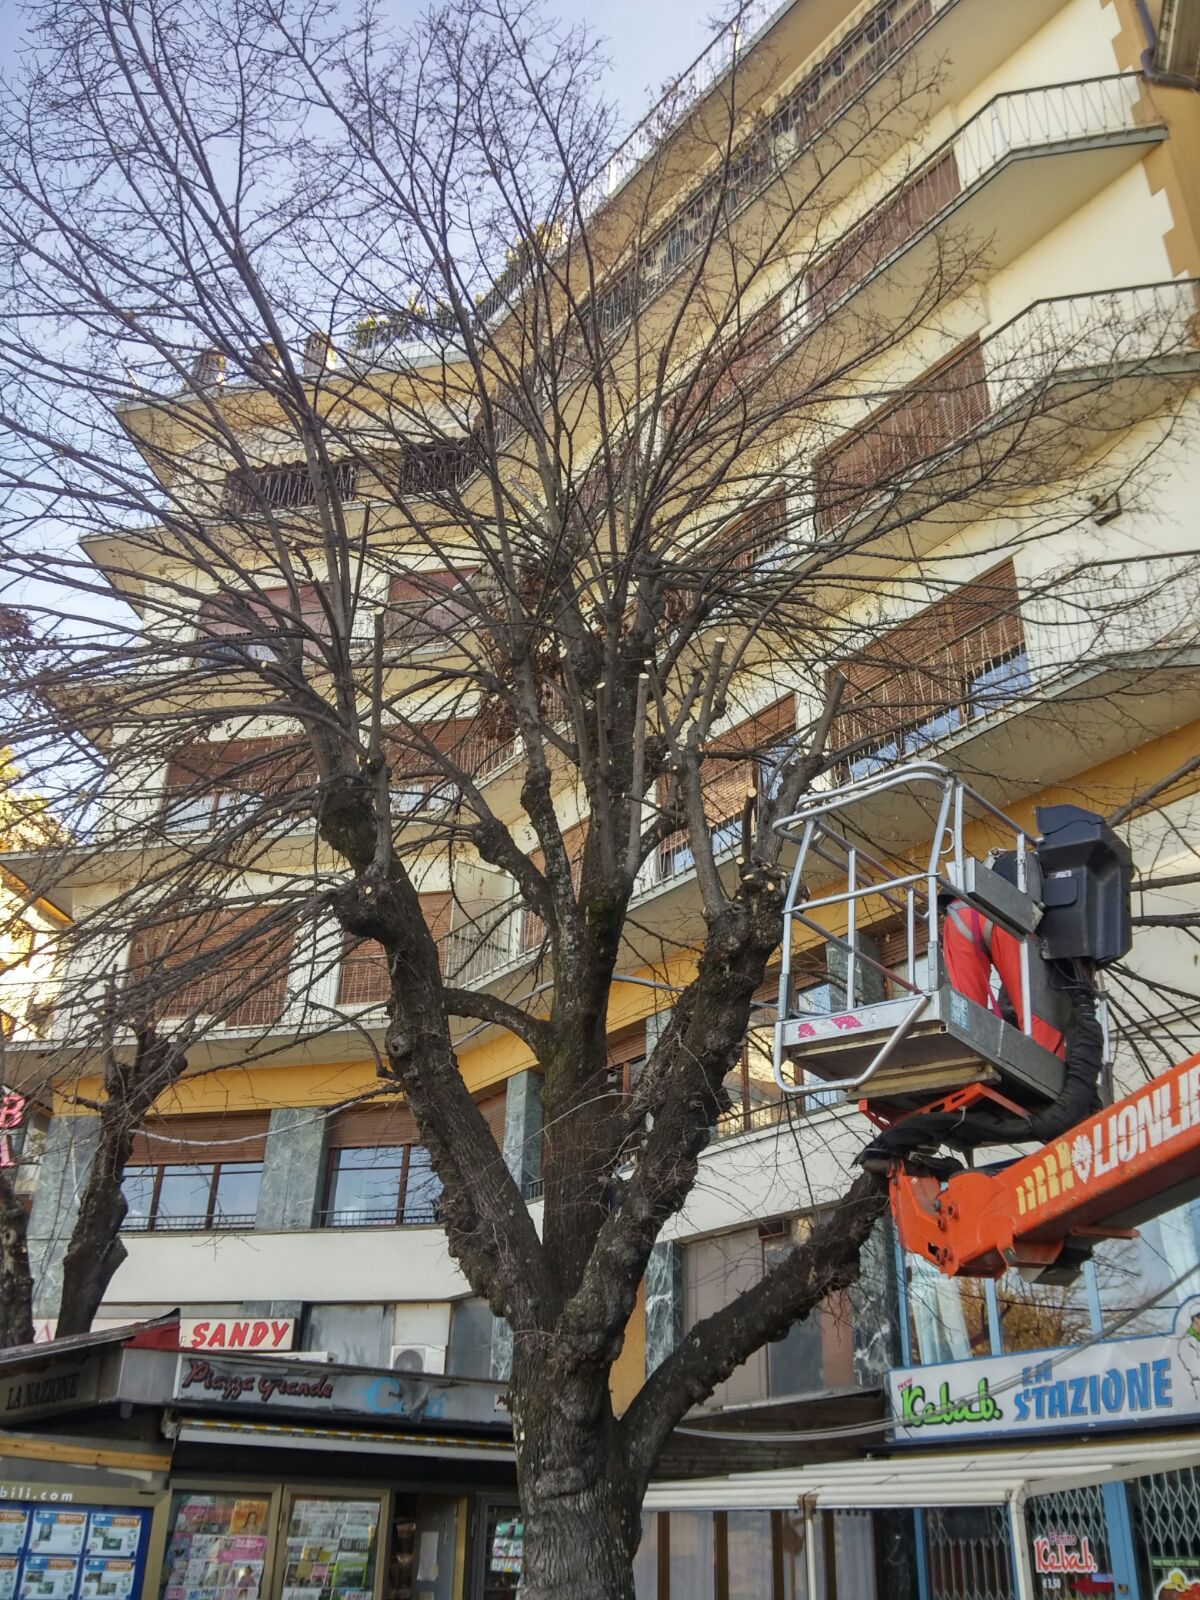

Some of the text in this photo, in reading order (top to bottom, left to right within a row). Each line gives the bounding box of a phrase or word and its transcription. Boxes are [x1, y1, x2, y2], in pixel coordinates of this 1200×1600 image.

[191, 1321, 290, 1348] SANDY
[182, 1358, 255, 1400] Piazza
[258, 1374, 334, 1402] Grande
[1014, 1357, 1172, 1421] STAZIONE
[1021, 1358, 1053, 1386] LA
[6, 1373, 80, 1410] LA NAZIONE
